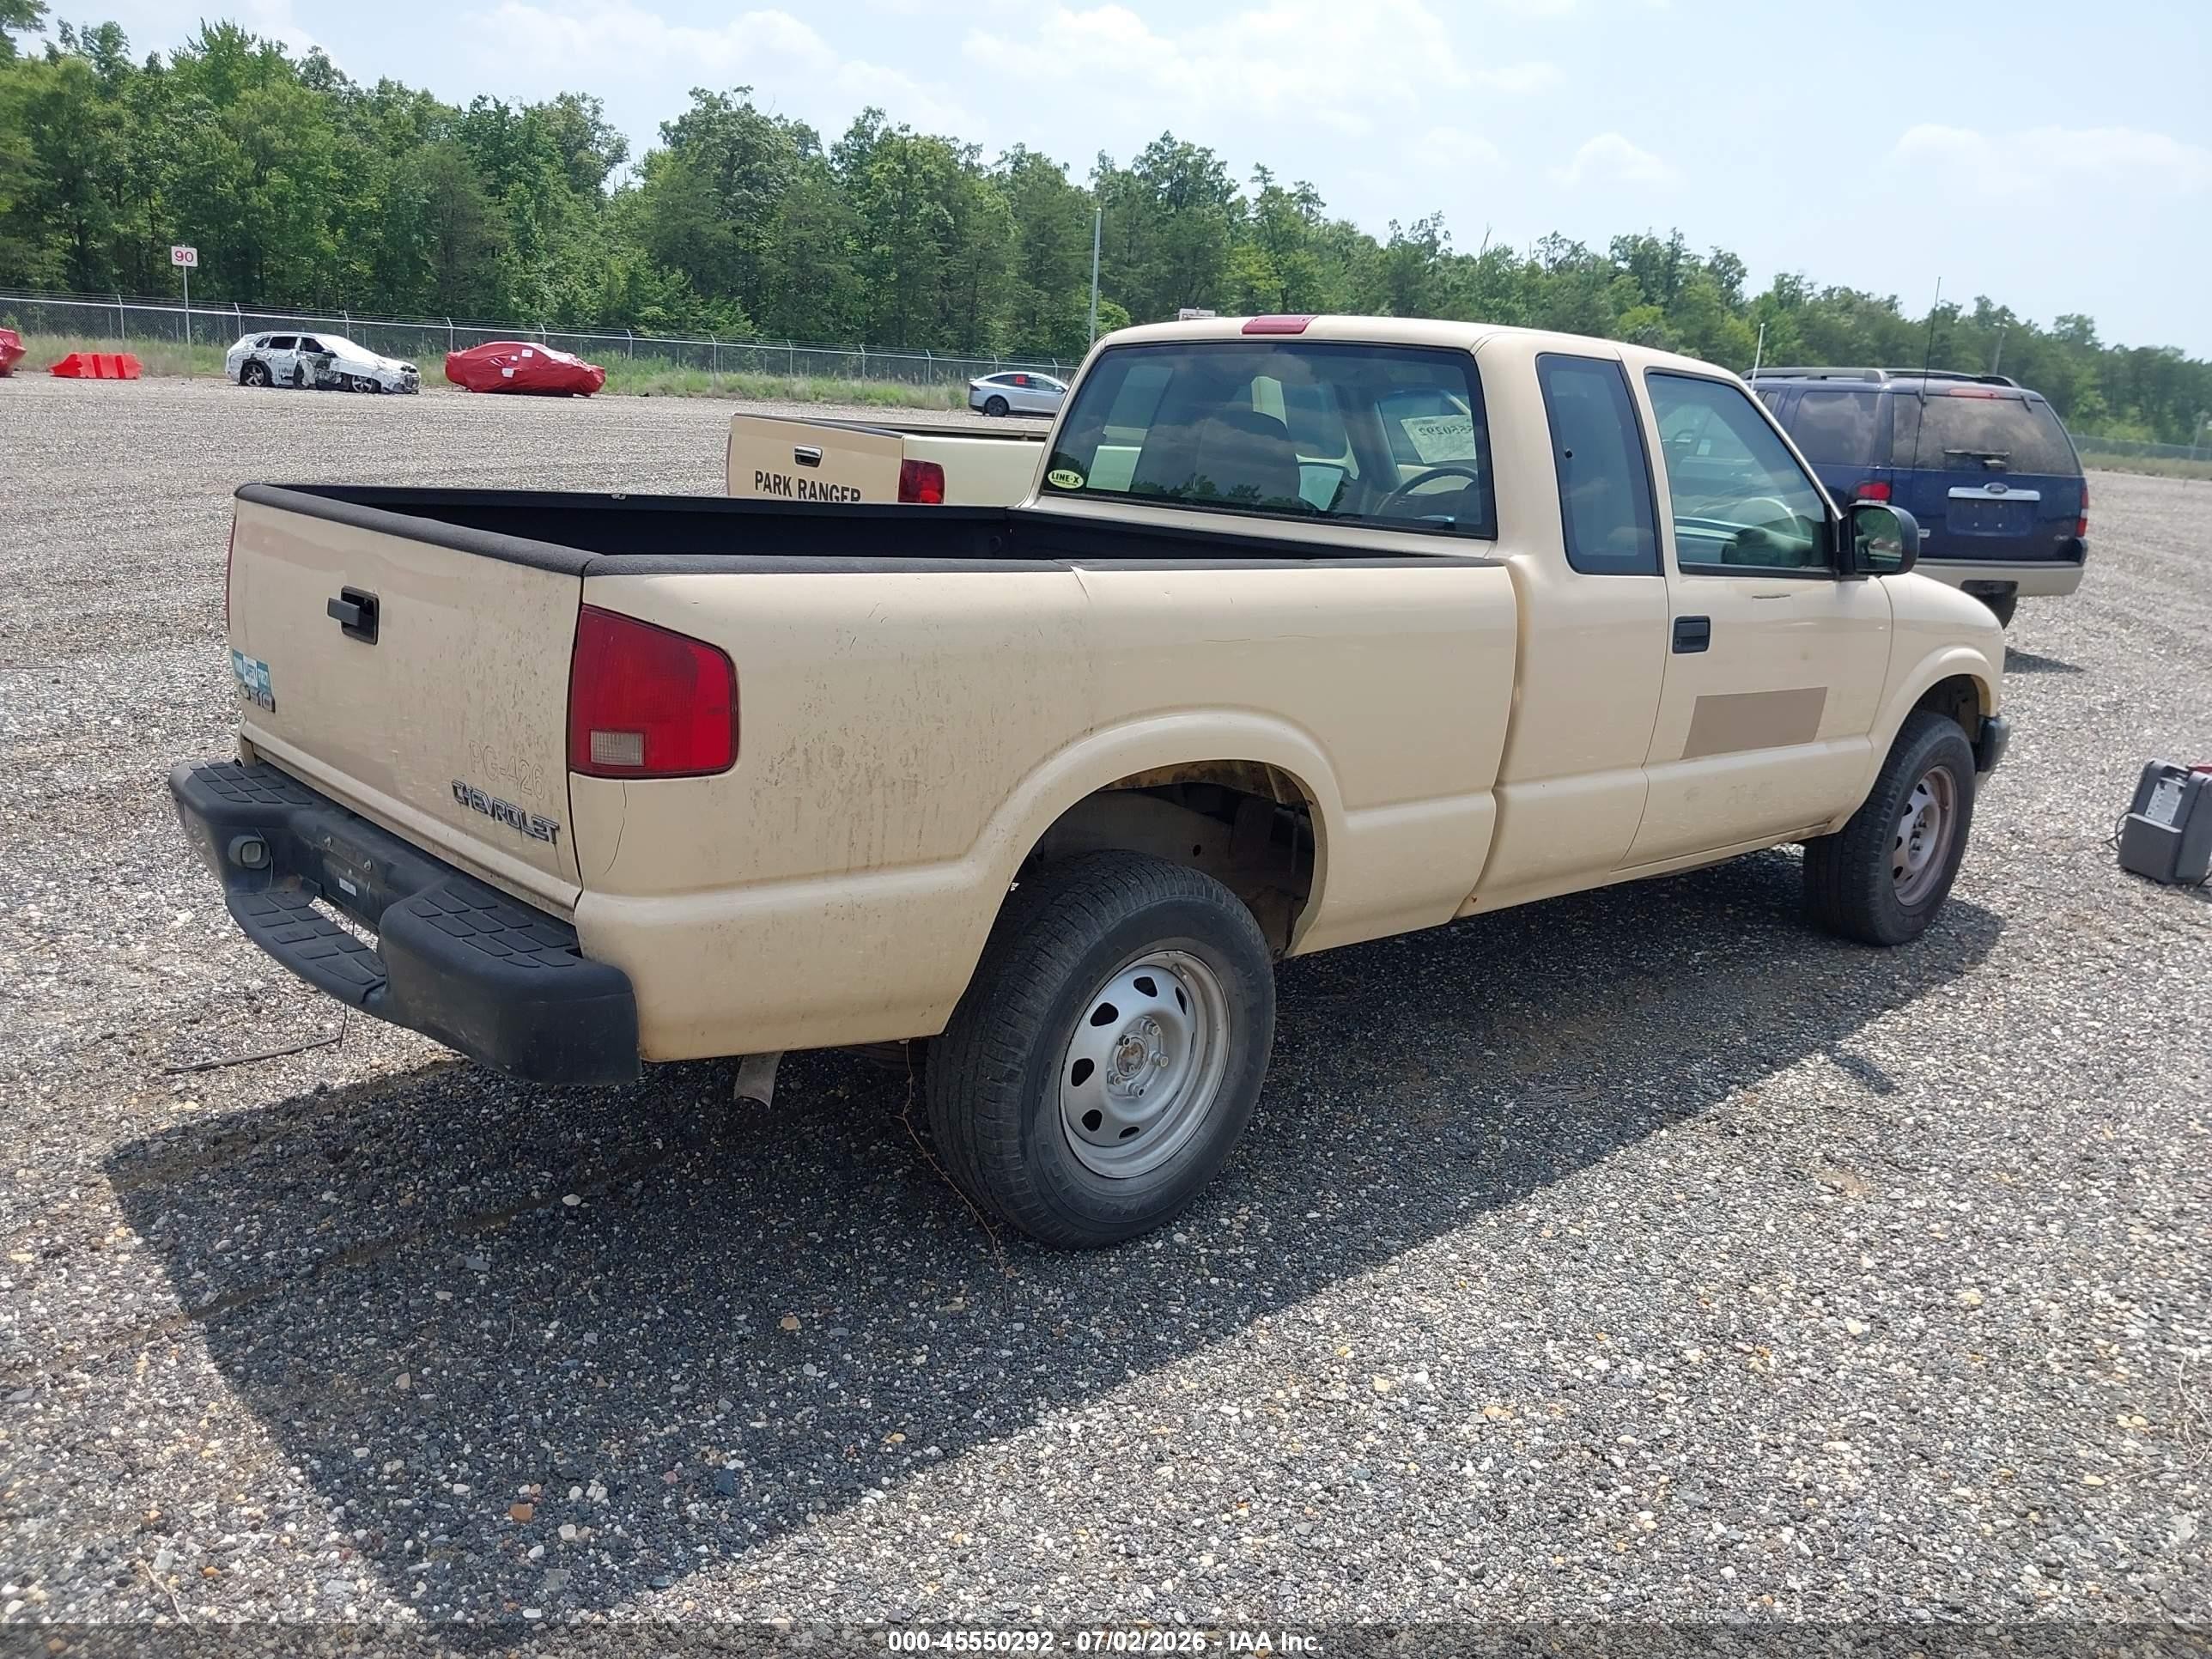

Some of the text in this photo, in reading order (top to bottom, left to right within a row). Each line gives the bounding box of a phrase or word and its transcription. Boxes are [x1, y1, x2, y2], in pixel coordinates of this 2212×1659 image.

[174, 250, 194, 263] 90
[755, 470, 861, 502] PARK RANGER
[1051, 471, 1079, 484] LINE-X
[452, 779, 560, 845] CHEVROLET
